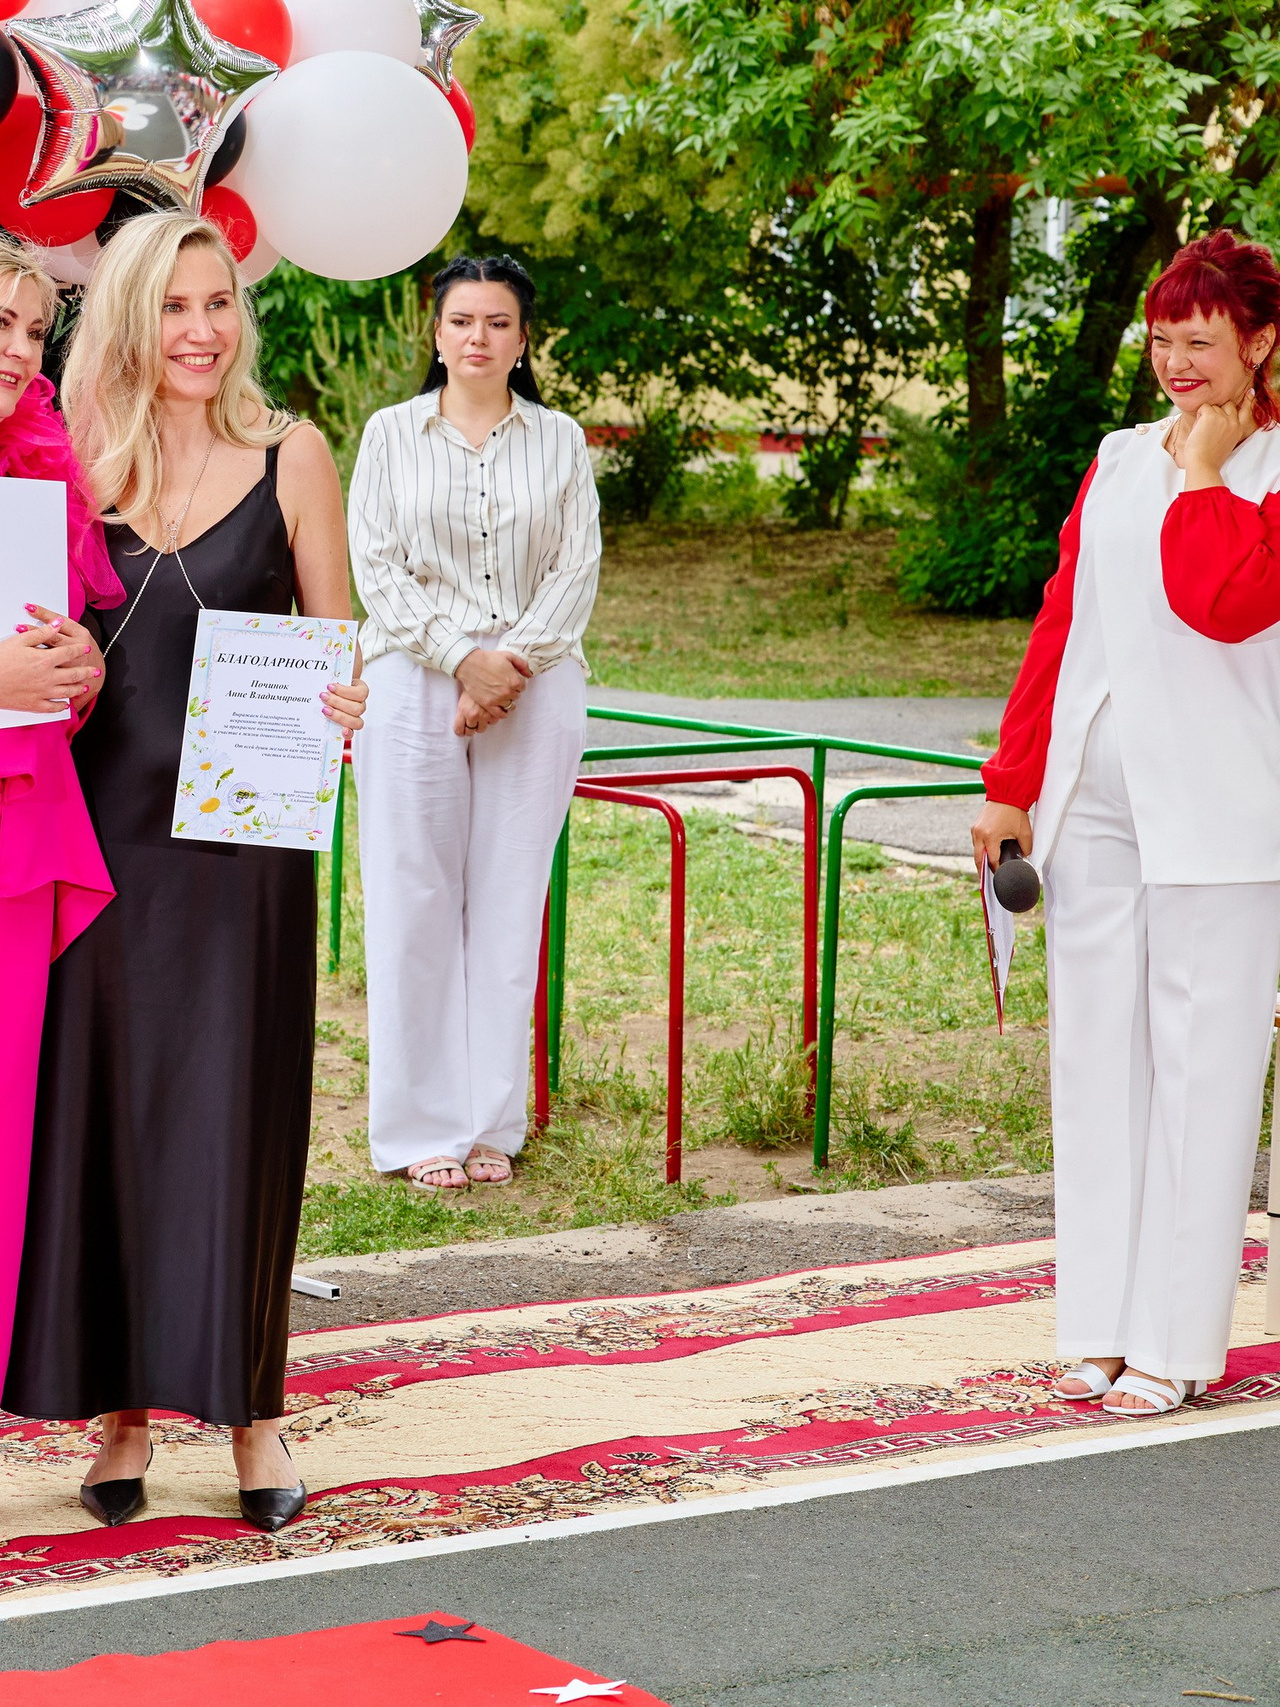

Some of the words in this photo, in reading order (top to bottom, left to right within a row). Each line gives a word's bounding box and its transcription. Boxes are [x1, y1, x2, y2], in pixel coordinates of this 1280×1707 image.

[217, 652, 329, 671] БЛАГОДАРНОСТЬ
[250, 680, 289, 691] Починок
[225, 690, 248, 699] Анне
[249, 691, 312, 704] Владимировне
